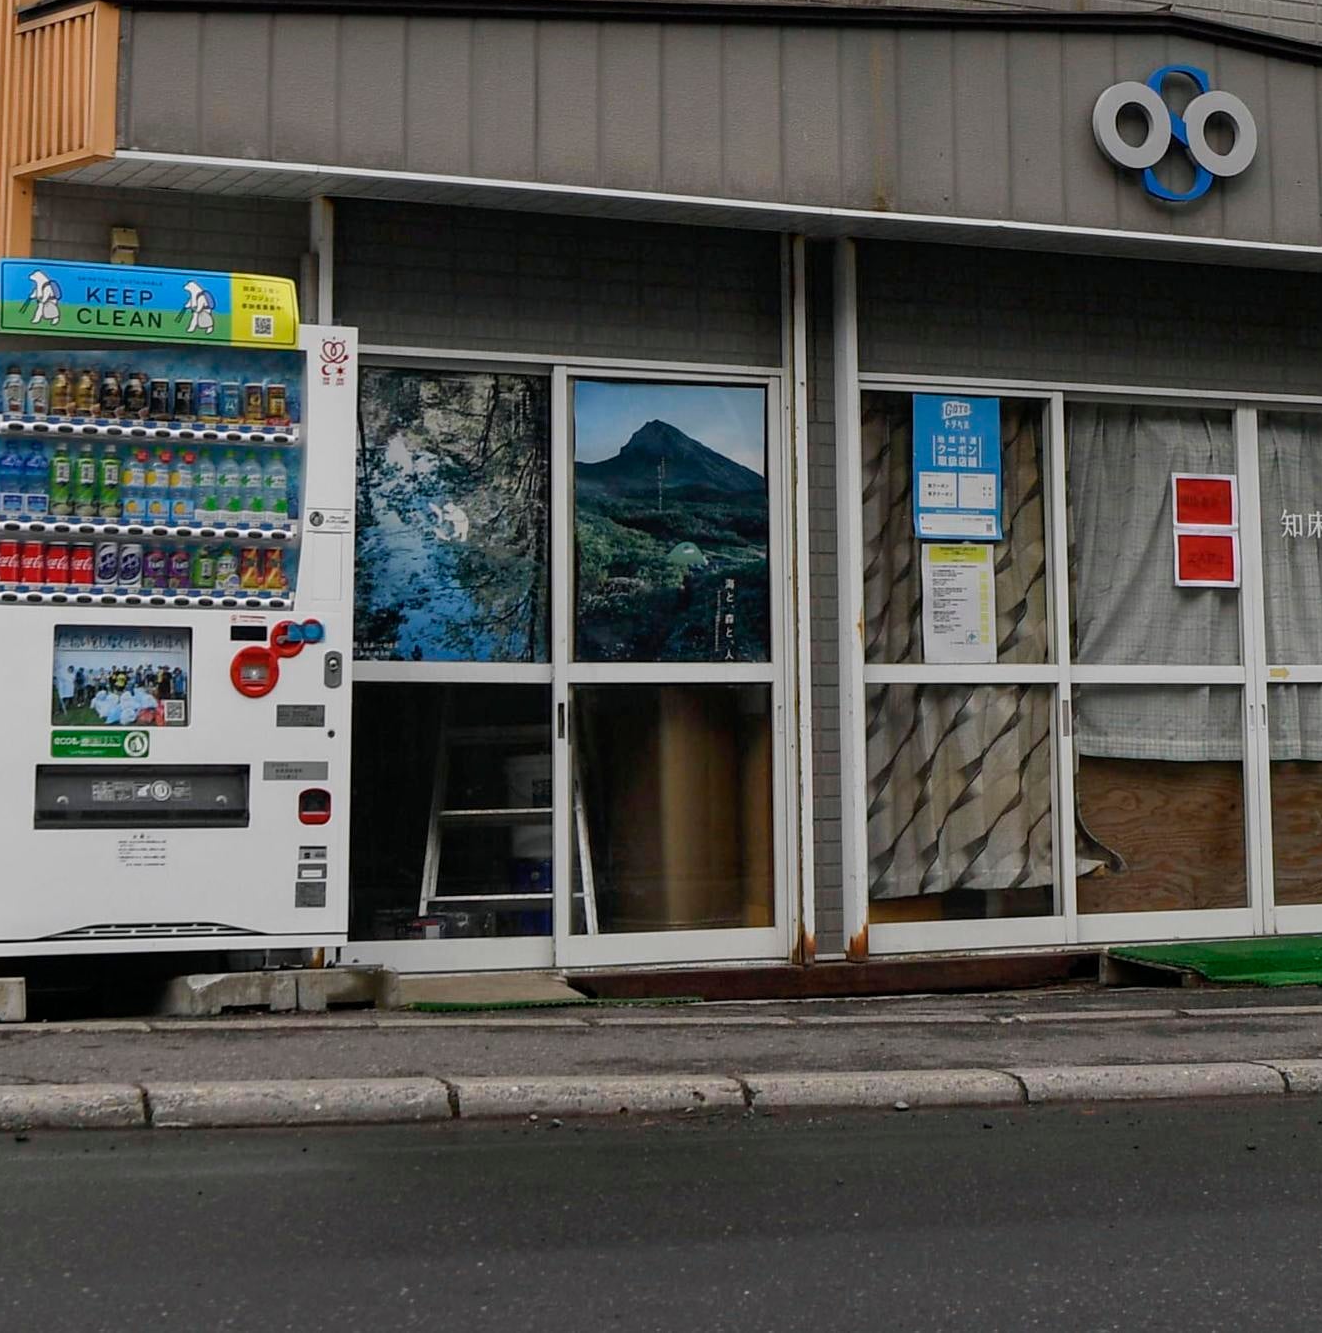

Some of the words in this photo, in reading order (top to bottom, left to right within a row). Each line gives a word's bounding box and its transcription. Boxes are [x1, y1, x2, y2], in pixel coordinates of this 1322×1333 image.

[87, 286, 154, 305] KEEP
[76, 308, 163, 329] CLEAN
[937, 444, 978, 456] クーポン
